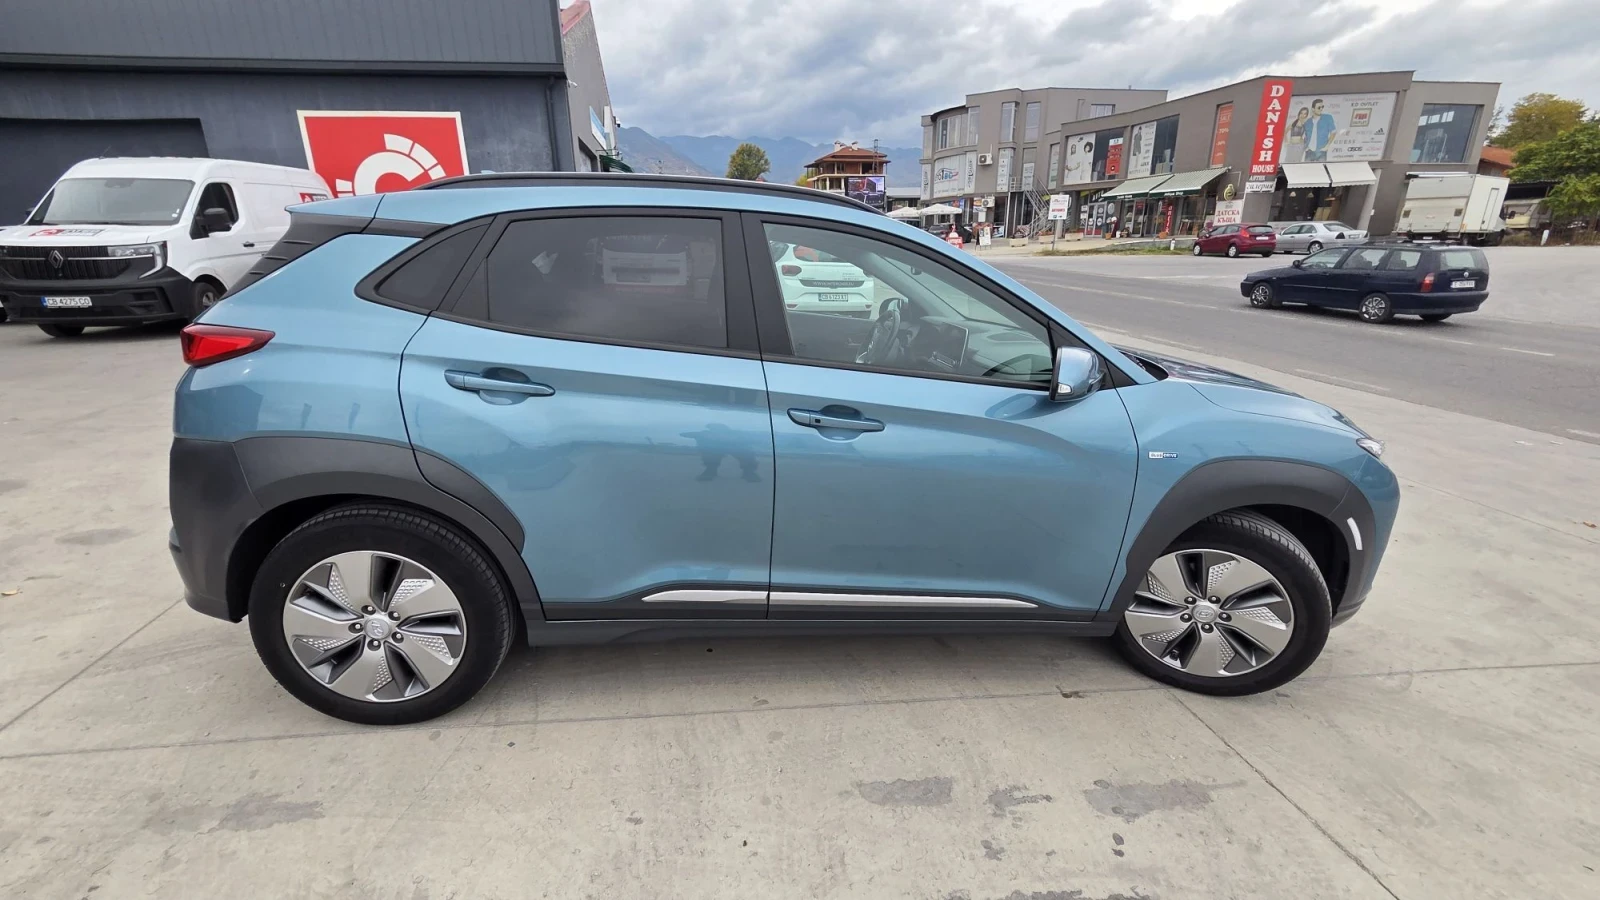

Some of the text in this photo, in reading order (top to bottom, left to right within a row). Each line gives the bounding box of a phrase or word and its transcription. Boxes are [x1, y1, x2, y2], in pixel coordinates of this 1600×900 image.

[1258, 85, 1285, 162] DANISH
[1251, 164, 1275, 173] HOUSE
[46, 298, 90, 306] CB 4275 CO
